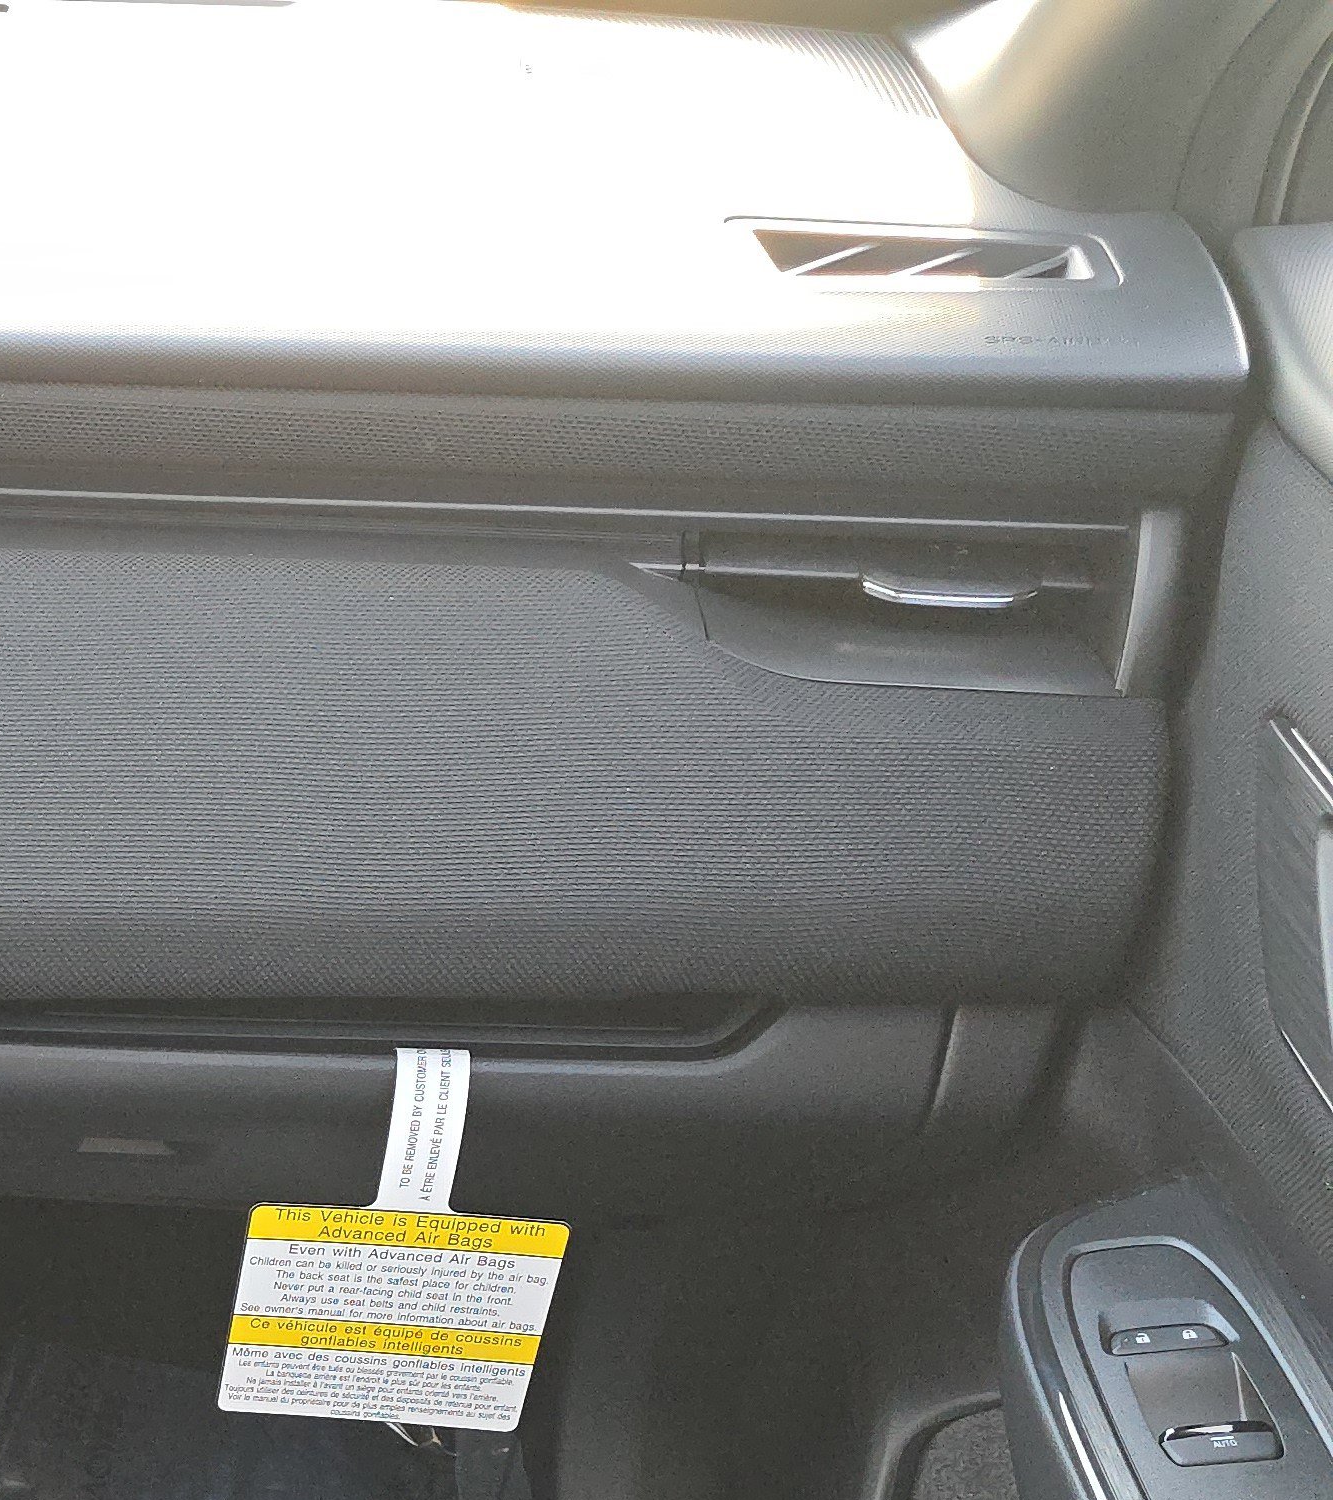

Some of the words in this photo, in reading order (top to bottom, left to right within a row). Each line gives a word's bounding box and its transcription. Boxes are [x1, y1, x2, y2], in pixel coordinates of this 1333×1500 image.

[439, 1071, 452, 1101] CLIENT
[412, 1105, 423, 1117] BY
[437, 1103, 448, 1115] LE
[433, 1116, 445, 1136] PAR
[405, 1119, 421, 1161] REMOVED
[402, 1164, 413, 1175] BE
[399, 1177, 411, 1188] TO
[275, 1208, 311, 1221] This
[321, 1210, 384, 1225] Vehicle
[392, 1215, 407, 1226] is
[417, 1215, 502, 1233] Equipped
[510, 1223, 545, 1236] with
[317, 1225, 406, 1242] Advanced
[412, 1231, 440, 1245] Air
[447, 1232, 492, 1249] Bags
[288, 1243, 325, 1255] Even
[332, 1246, 361, 1257] with
[367, 1248, 443, 1263] Advanced
[447, 1253, 471, 1265] Air
[476, 1255, 515, 1270] Bags
[249, 1255, 291, 1267] Children
[318, 1259, 331, 1269] be
[334, 1260, 362, 1270] killed
[380, 1263, 427, 1277] seriously
[430, 1266, 466, 1278] injured
[470, 1269, 484, 1281] by
[487, 1270, 504, 1280] the
[508, 1272, 523, 1282] air
[526, 1274, 548, 1286] bag.
[275, 1269, 295, 1278] The
[298, 1270, 324, 1280] back
[327, 1273, 350, 1282] seat
[353, 1273, 362, 1282] is
[366, 1274, 382, 1284] the
[386, 1276, 418, 1286] safest
[421, 1278, 450, 1289] place
[454, 1280, 469, 1290] for
[472, 1281, 516, 1294] children.
[273, 1281, 304, 1291] Never
[306, 1284, 324, 1293] put
[327, 1285, 334, 1293] a
[338, 1286, 393, 1298] rear-facing
[397, 1288, 422, 1298] child
[425, 1292, 448, 1300] seat
[452, 1292, 461, 1301] in
[466, 1293, 482, 1303] the
[486, 1294, 512, 1305] front.
[279, 1293, 316, 1305] Always
[343, 1298, 365, 1307] seat
[369, 1298, 393, 1308] belts
[397, 1301, 418, 1310] and
[421, 1302, 446, 1312] child
[449, 1306, 499, 1316] restraints.
[239, 1302, 260, 1312] See
[264, 1305, 303, 1314] owner's
[307, 1308, 347, 1317] manual
[348, 1308, 364, 1319] for
[366, 1312, 393, 1320] more
[396, 1312, 453, 1324] information
[457, 1316, 487, 1327] about
[490, 1319, 506, 1328] air
[508, 1320, 537, 1331] bags.
[250, 1317, 270, 1329] Ce
[277, 1318, 337, 1333] véhicule
[345, 1324, 367, 1335] est
[373, 1325, 423, 1339] équipé
[430, 1329, 449, 1340] de
[455, 1331, 523, 1346] coussins
[300, 1333, 376, 1348] gonflables
[382, 1338, 463, 1355] intelligents
[232, 1346, 268, 1358] Même
[273, 1351, 303, 1360] avec
[307, 1351, 329, 1364] des
[334, 1355, 387, 1367] coussins
[392, 1358, 455, 1371] gonflables
[459, 1362, 525, 1376] intelligents
[1213, 1439, 1238, 1449] AUTO
